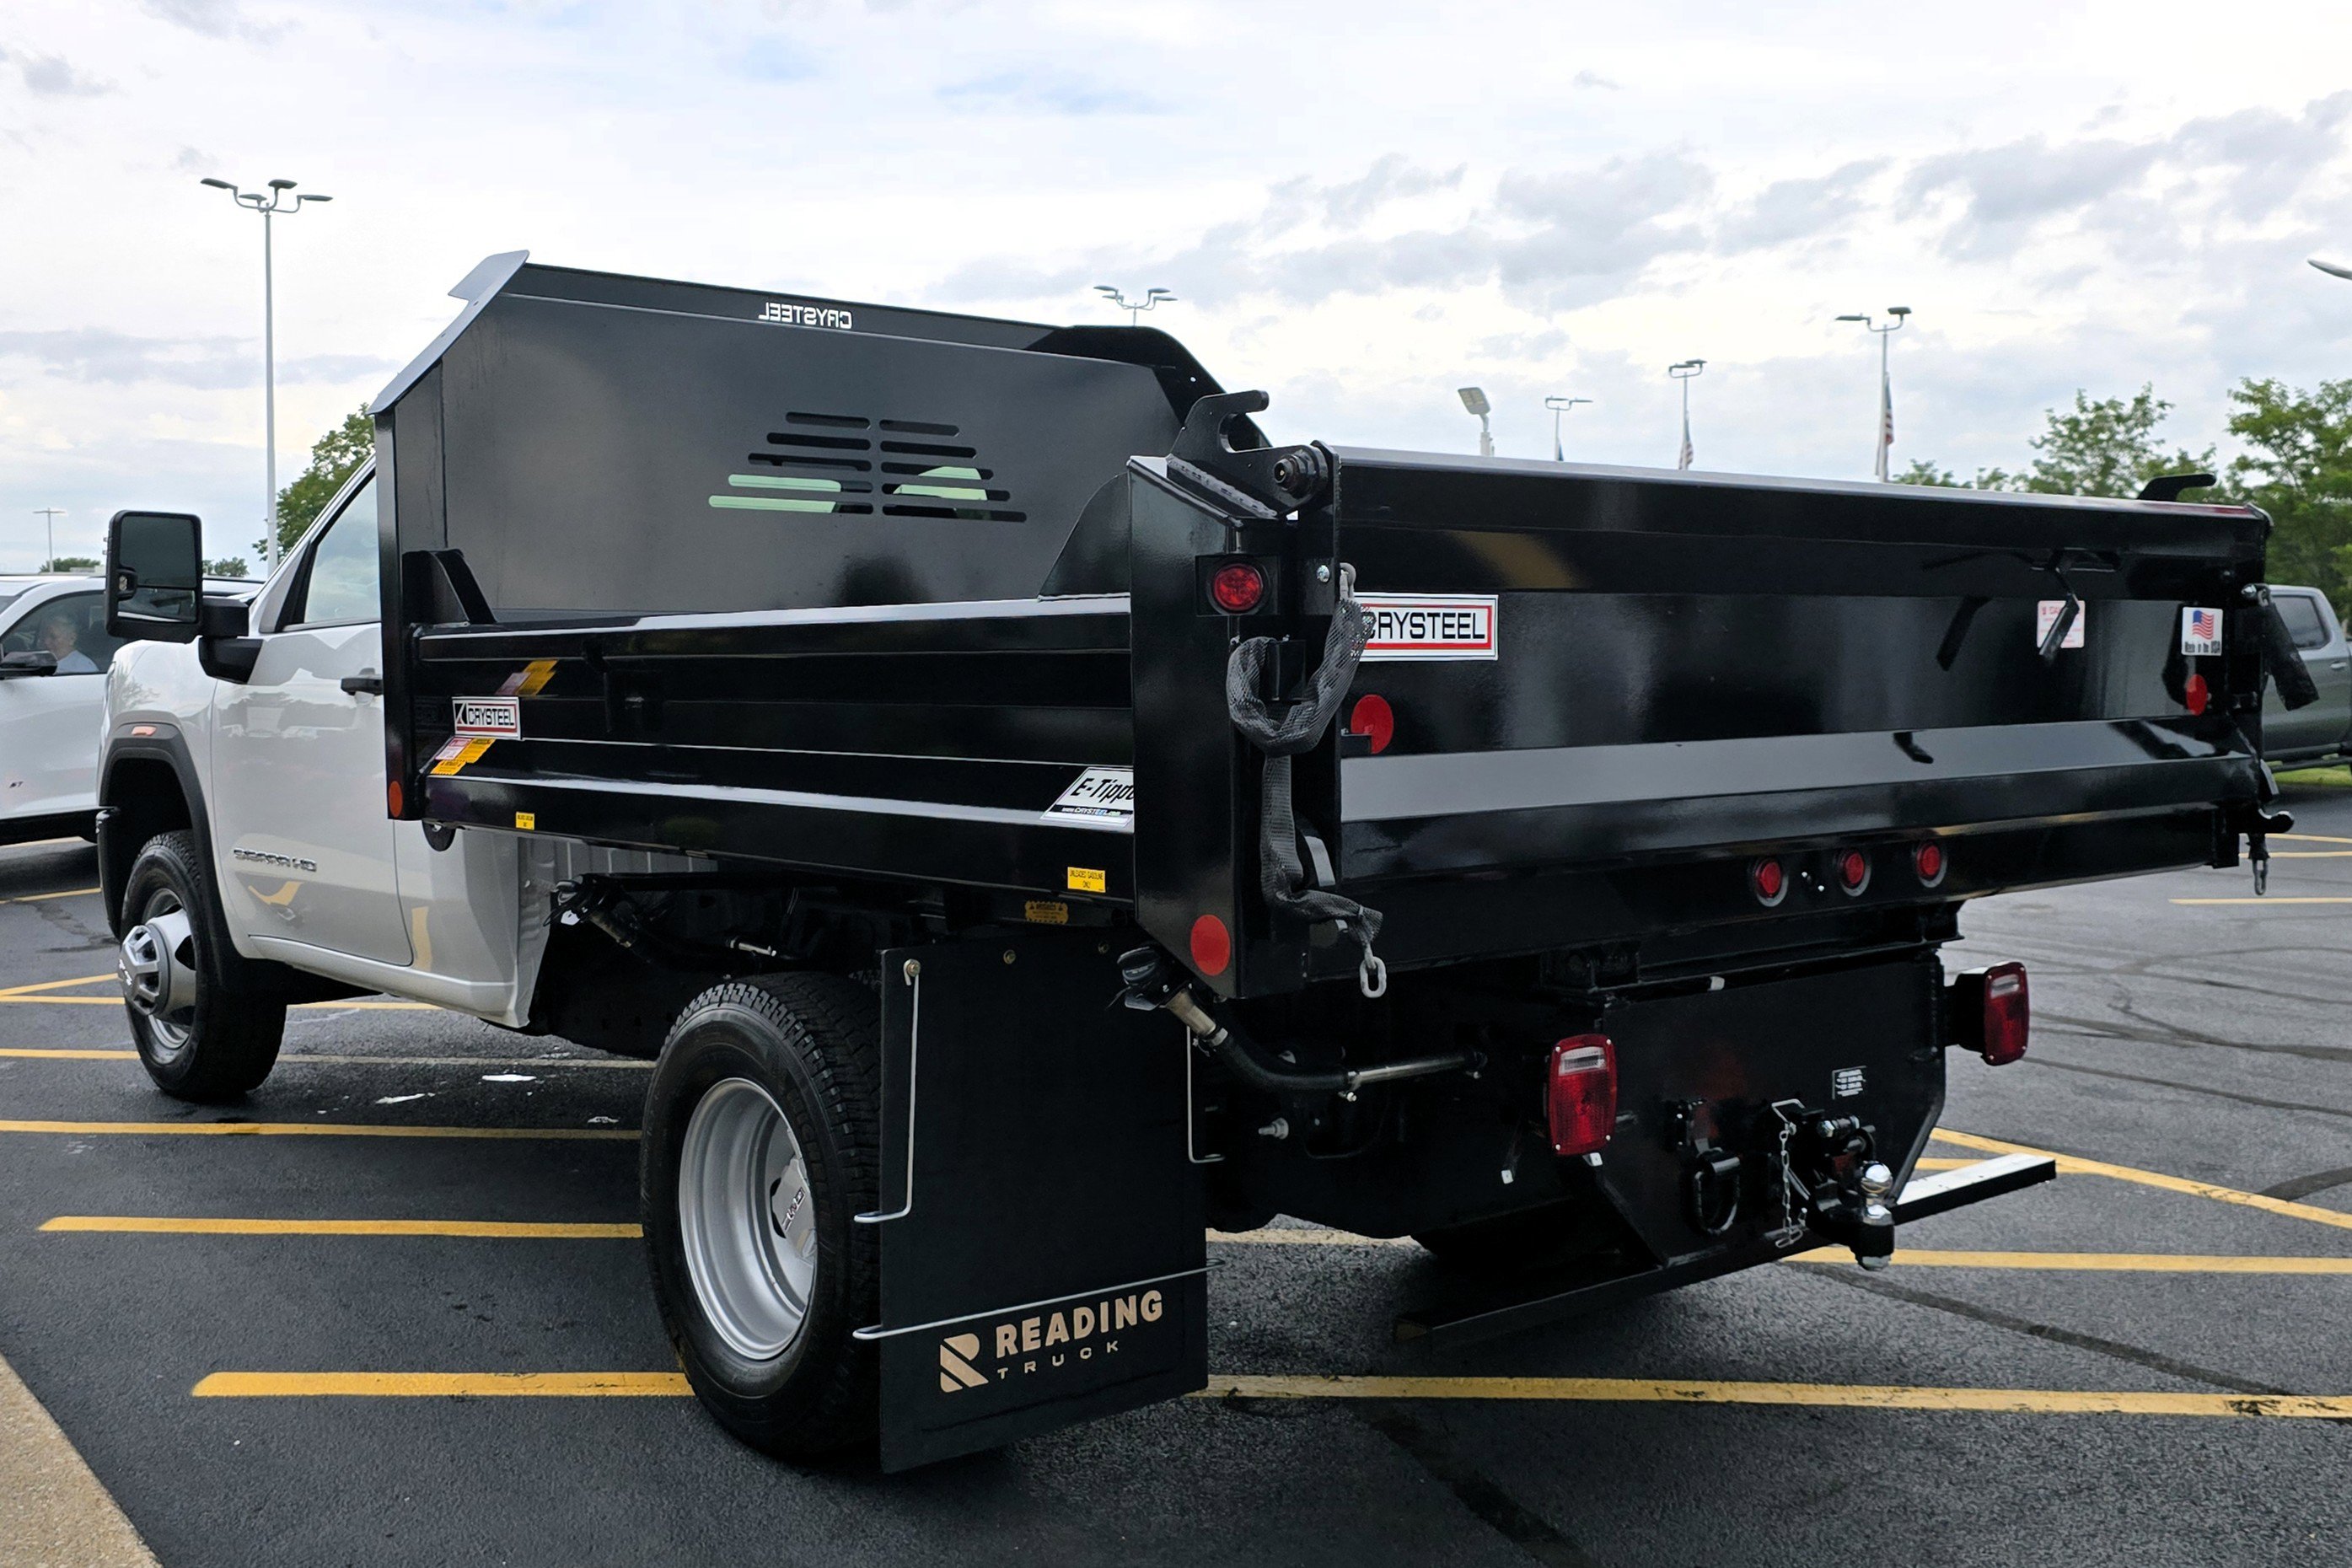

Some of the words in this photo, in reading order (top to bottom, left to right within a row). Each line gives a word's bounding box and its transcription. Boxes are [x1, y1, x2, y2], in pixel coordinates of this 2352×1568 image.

[468, 707, 515, 726] CRYSTEEL
[996, 1289, 1163, 1359] READING
[997, 1340, 1120, 1380] TRUCK
